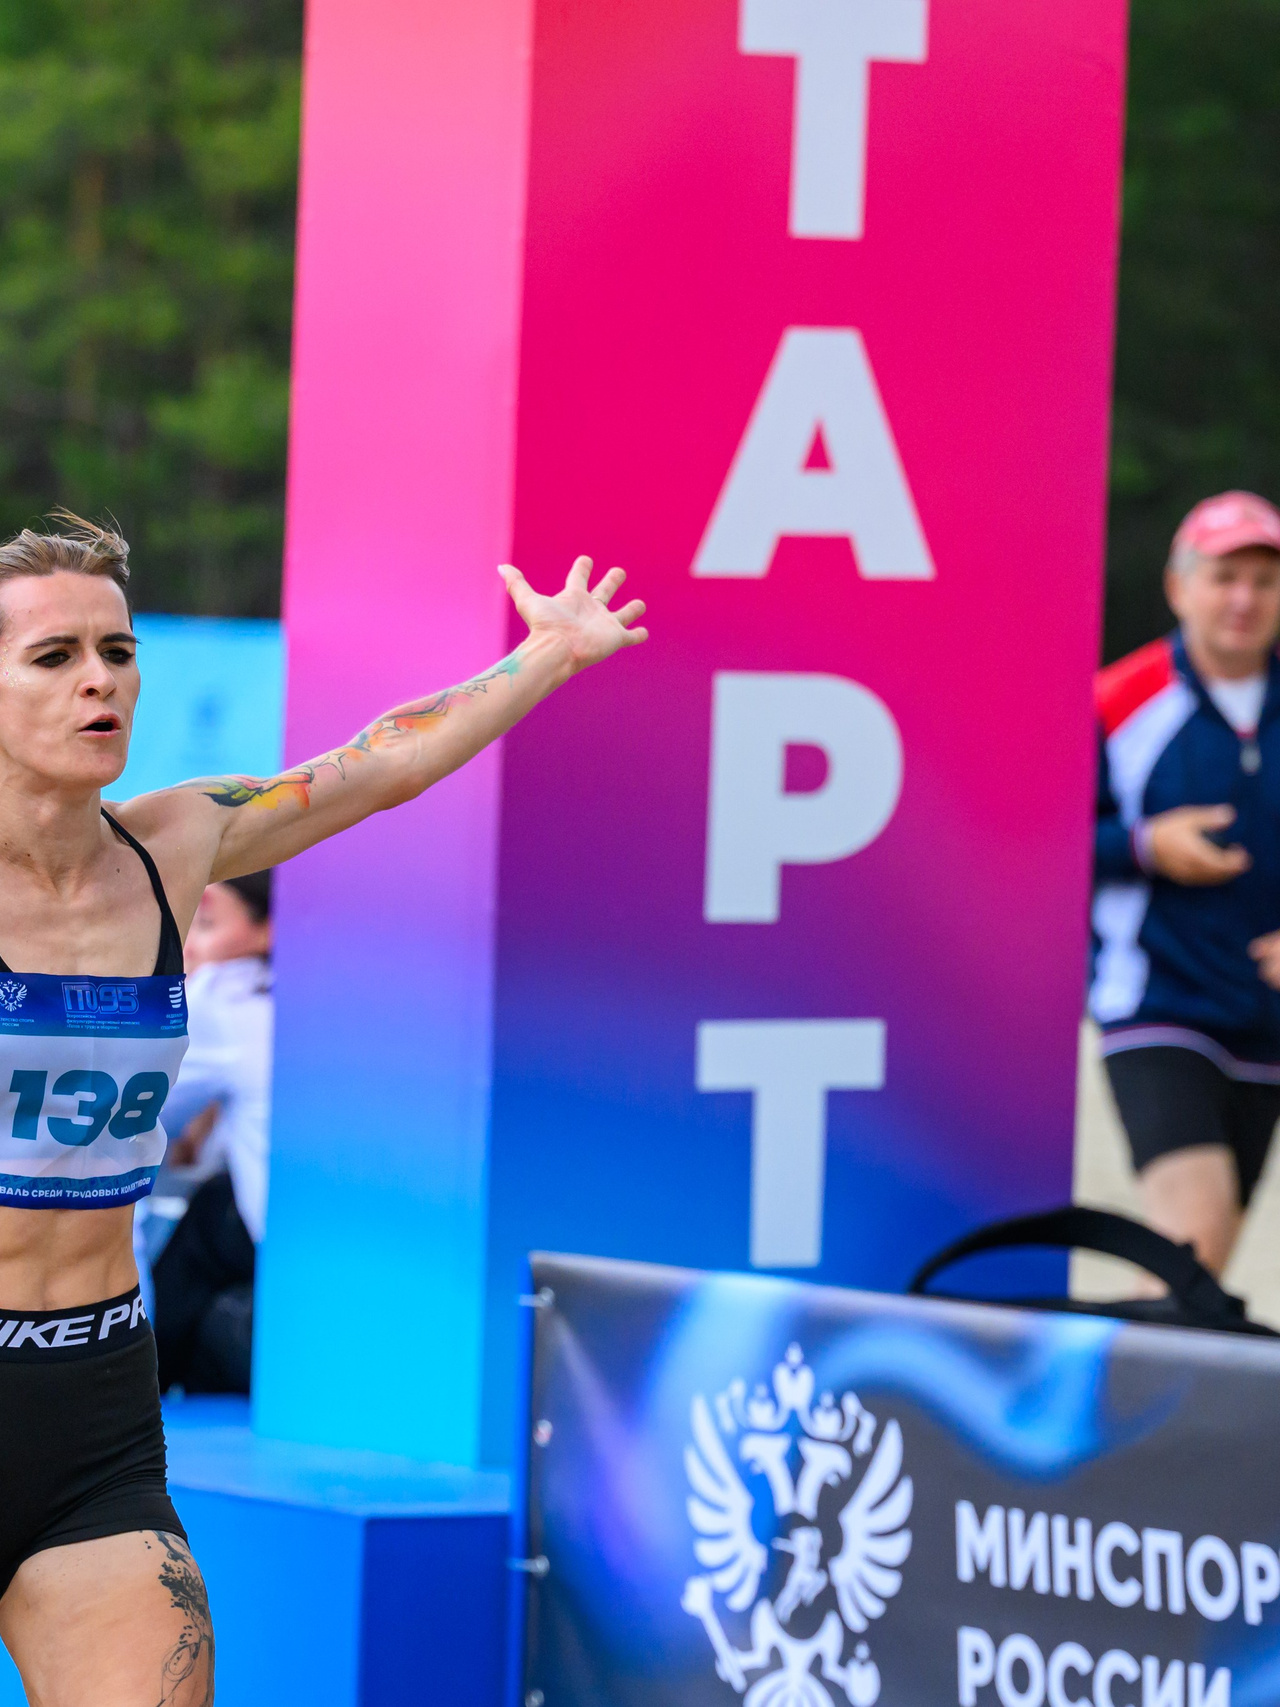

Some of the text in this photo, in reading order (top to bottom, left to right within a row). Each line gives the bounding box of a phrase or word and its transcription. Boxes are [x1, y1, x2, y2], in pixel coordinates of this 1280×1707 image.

[9, 1069, 169, 1147] 138
[31, 1188, 63, 1198] СРЕДИ
[65, 1187, 119, 1199] ТРУДОВЫХ
[955, 1499, 1280, 1626] МИНСПОР
[956, 1625, 1232, 1707] РОССИИ
